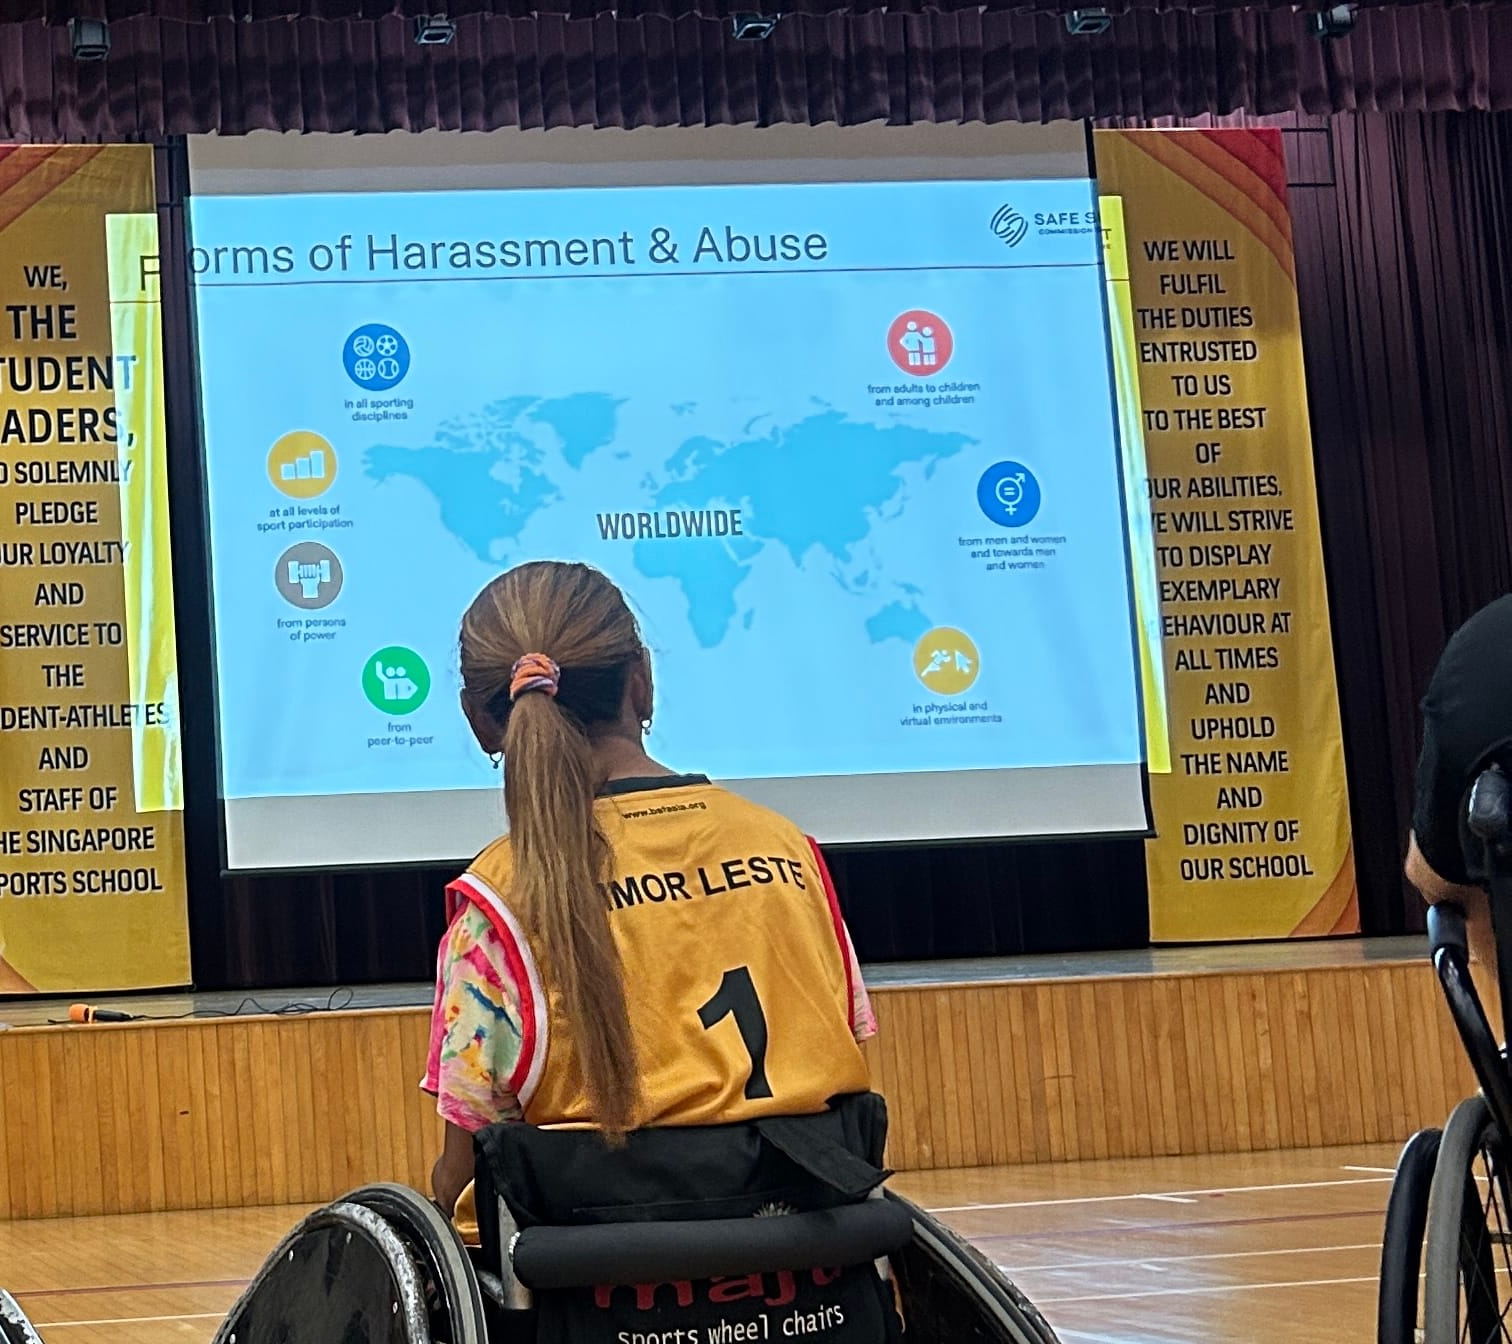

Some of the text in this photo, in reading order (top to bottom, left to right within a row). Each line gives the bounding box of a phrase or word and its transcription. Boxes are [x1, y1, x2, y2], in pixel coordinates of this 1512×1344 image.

[1034, 212, 1079, 226] SAFE
[140, 225, 828, 290] Forms of Harassment & Abuse
[1144, 239, 1234, 261] WE WILL
[24, 265, 68, 292] WE,
[1160, 274, 1226, 295] FULFIL
[6, 304, 77, 340] THE
[1138, 307, 1253, 329] THE DUTIES
[1140, 341, 1257, 363] ENTRUSTED
[867, 382, 981, 394] from adults to children
[1171, 374, 1231, 396] TO US
[344, 398, 414, 410] in all sporting
[875, 394, 975, 408] and among children
[351, 410, 408, 423] disciplines
[1144, 407, 1266, 431] TO THE BEST
[1195, 443, 1221, 463] OF
[15, 460, 132, 484] SOLEMNLY
[1188, 475, 1282, 498] ABILITIES,
[15, 501, 98, 524] PLEDGE
[269, 504, 340, 518] at all levels of
[1171, 511, 1224, 533] WILL
[1229, 509, 1293, 532] STRIVE
[256, 518, 354, 533] sport participation
[596, 510, 743, 540] WORLDWIDE
[958, 534, 1067, 546] from men and women
[40, 541, 130, 565] LOYALTY
[970, 547, 1056, 559] and towards men
[1157, 544, 1272, 567] TO DISPLAY
[986, 560, 1045, 571] and women
[34, 583, 85, 606] AND
[1160, 578, 1280, 602] EXEMPLARY
[0, 622, 122, 648] SERVICE TO
[277, 618, 347, 630] from persons
[1161, 612, 1291, 637] EHAVIOUR AT
[290, 629, 337, 643] of power
[1175, 647, 1279, 671] ALL TIMES
[41, 664, 84, 687] THE
[1205, 682, 1251, 705] AND
[912, 700, 988, 715] in physical and
[388, 721, 412, 733] from
[900, 714, 1002, 726] virtual environments
[1191, 716, 1275, 740] UPHOLD
[367, 735, 434, 748] peer-to-peer
[39, 746, 89, 770] AND
[1180, 751, 1289, 775] THE NAME
[19, 786, 117, 812] STAFF OF
[1217, 786, 1262, 809] AND
[26, 826, 154, 853] SINGAPORE
[1184, 820, 1299, 845] DIGNITY OF
[1180, 855, 1313, 881] OUR SCHOOL
[72, 868, 163, 894] SCHOOL
[607, 856, 806, 912] MOR LESTE
[696, 966, 774, 1100] 1
[782, 1304, 845, 1338] chairs
